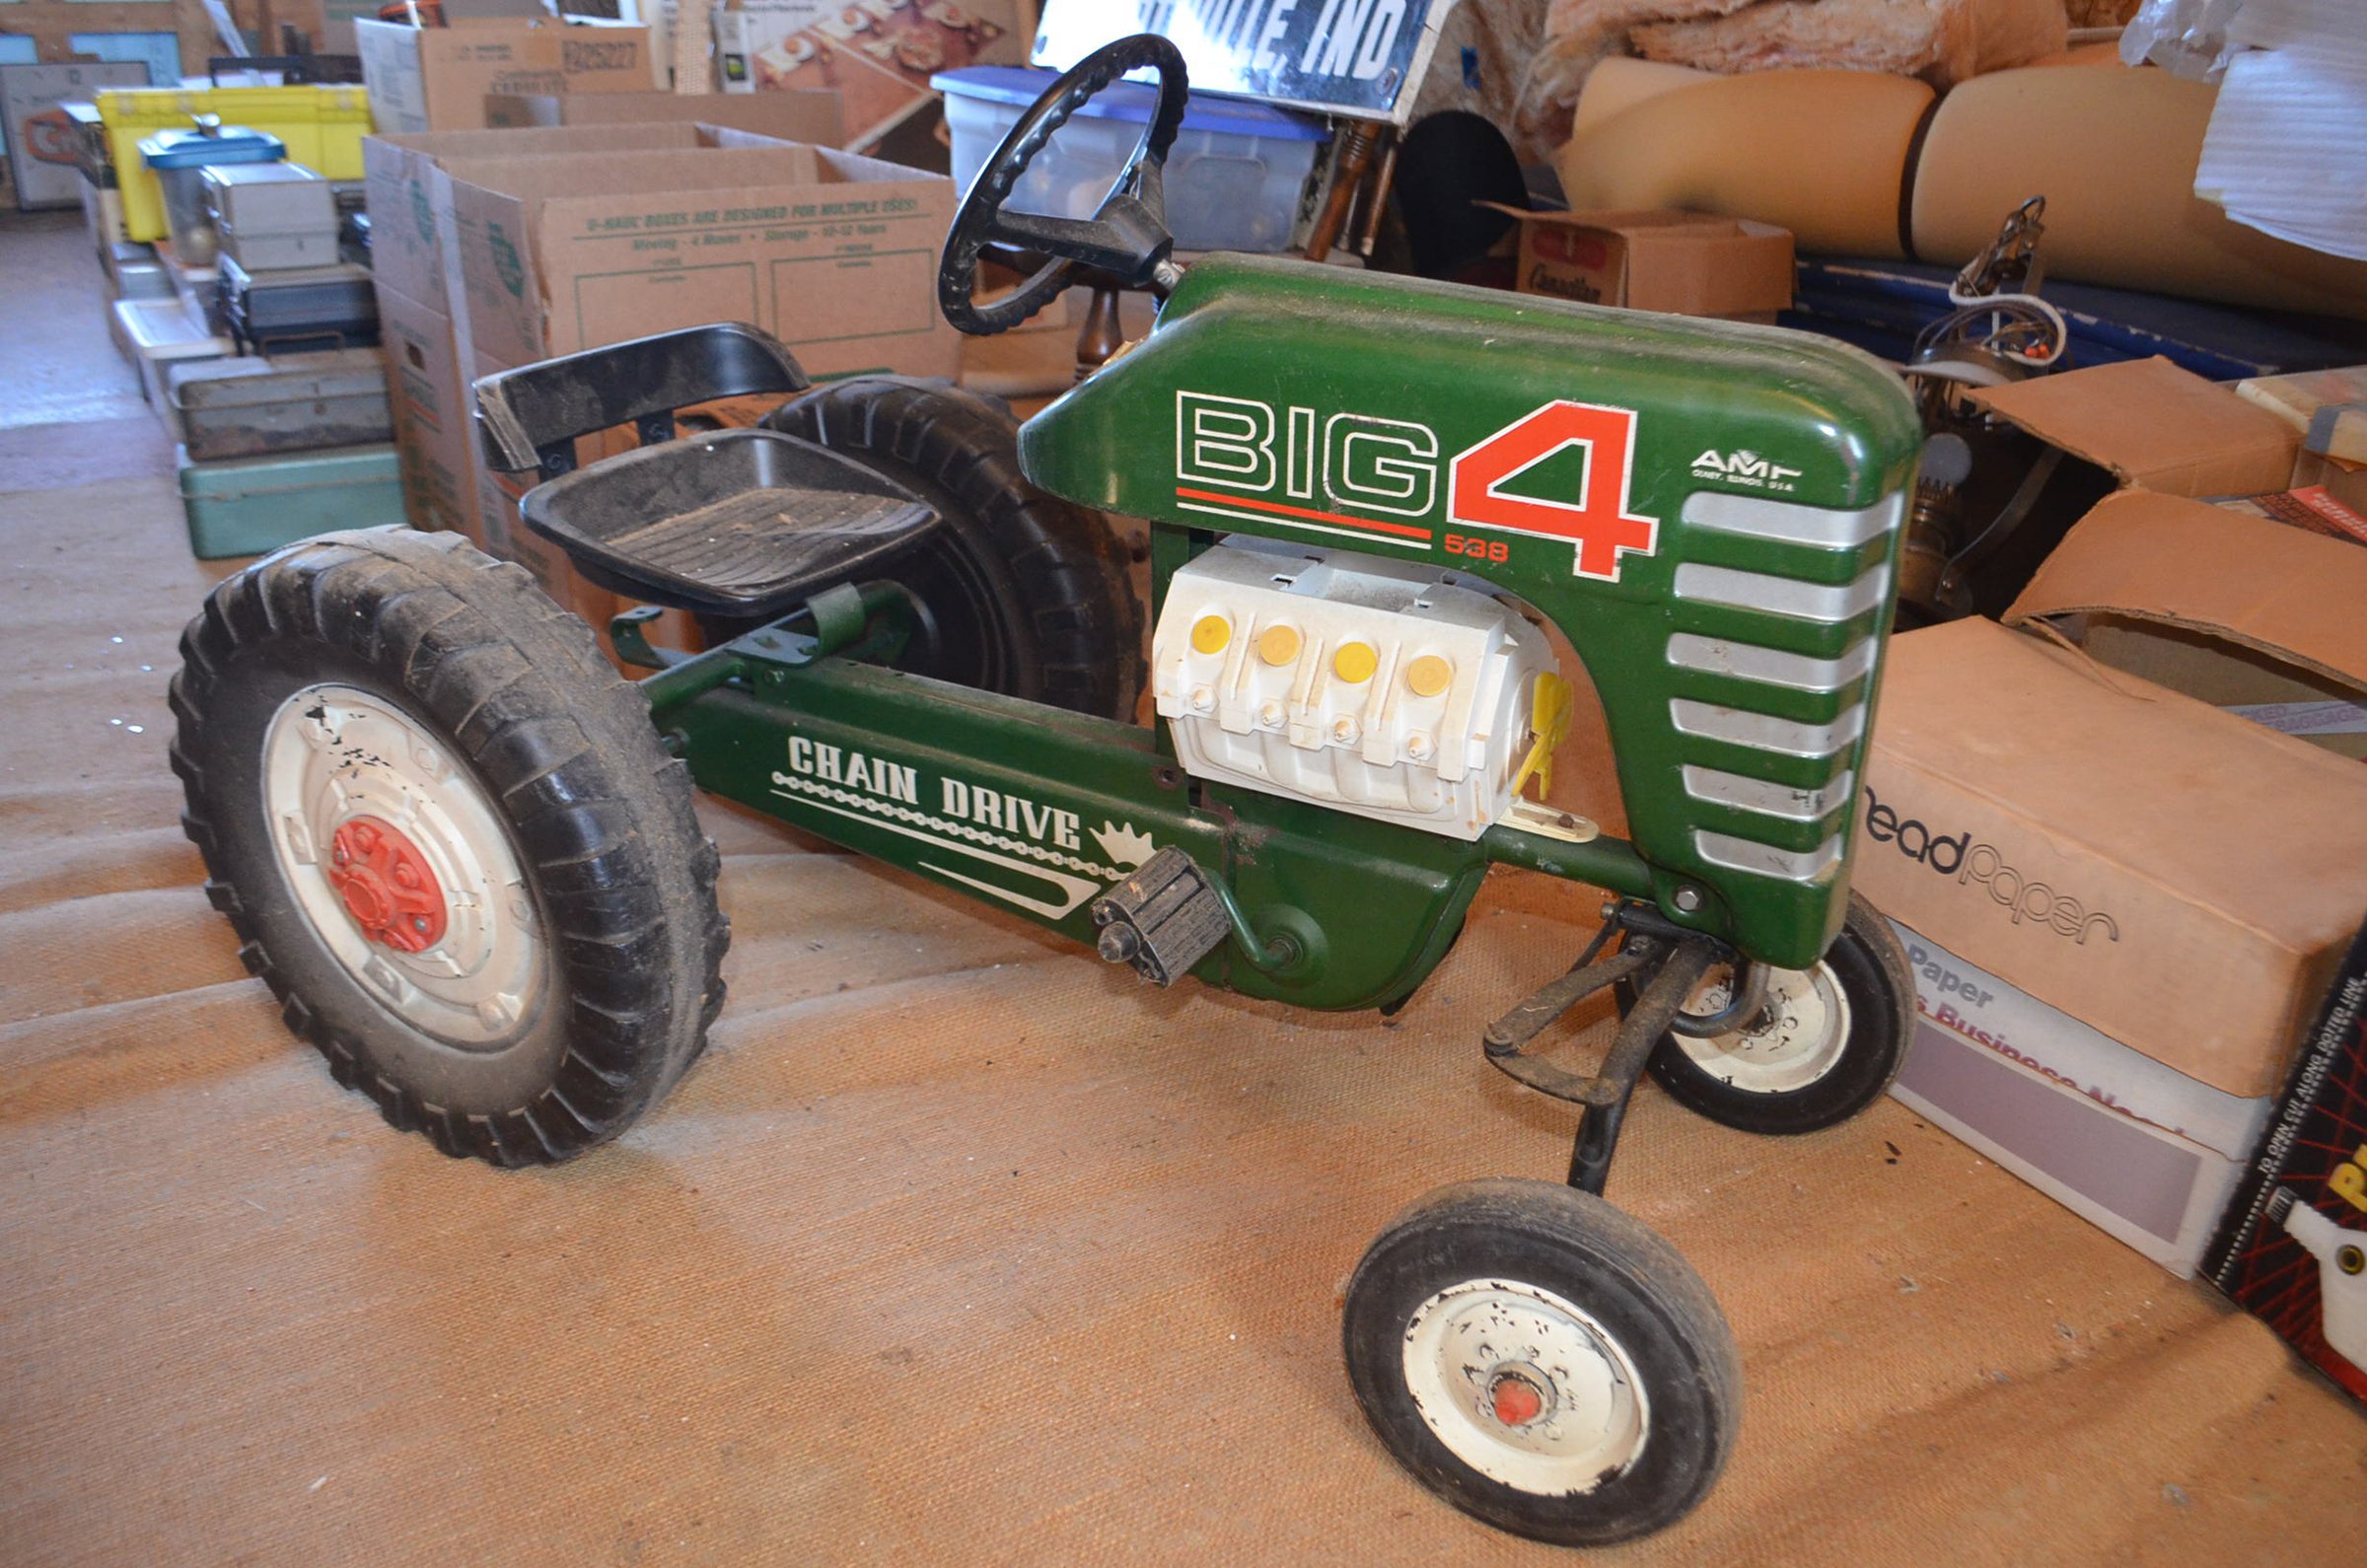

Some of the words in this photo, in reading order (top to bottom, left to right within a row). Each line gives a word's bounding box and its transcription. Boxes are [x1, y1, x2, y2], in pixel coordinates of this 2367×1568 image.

[643, 212, 688, 228] BOXES
[692, 209, 718, 224] ARE
[723, 205, 787, 222] DESIGNED
[792, 203, 817, 218] FOR
[821, 200, 878, 215] MULTIPLE
[1177, 391, 1439, 517] BIG
[1446, 398, 1661, 584] 4
[1444, 533, 1510, 563] 538
[788, 735, 920, 806] CHAIN
[941, 776, 1082, 851] DRIVE
[1907, 943, 1993, 1009] Paper
[2258, 1156, 2272, 1175] TO
[2266, 1122, 2290, 1156] OPEN
[2282, 1096, 2302, 1121] CUT
[2296, 1053, 2324, 1097] ALONG
[2317, 1005, 2346, 1052] DOTTED
[2338, 975, 2361, 1006] LINE
